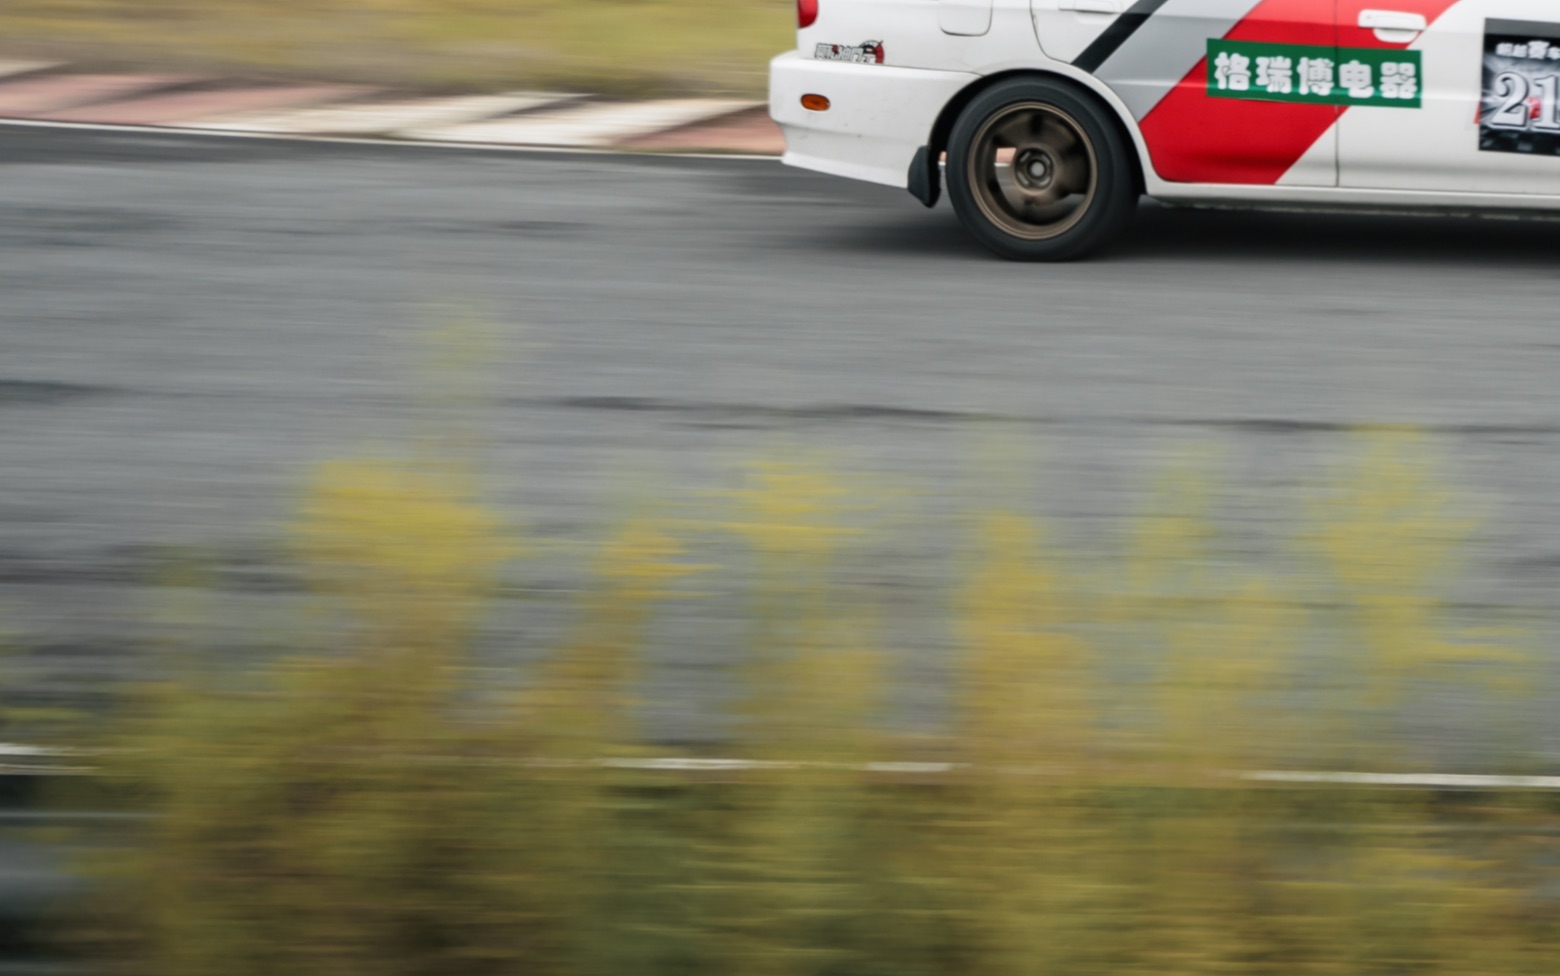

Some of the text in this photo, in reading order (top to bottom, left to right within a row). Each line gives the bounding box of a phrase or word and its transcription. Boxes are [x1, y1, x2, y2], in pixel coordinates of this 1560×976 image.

[1214, 51, 1418, 100] 格瑞博电器
